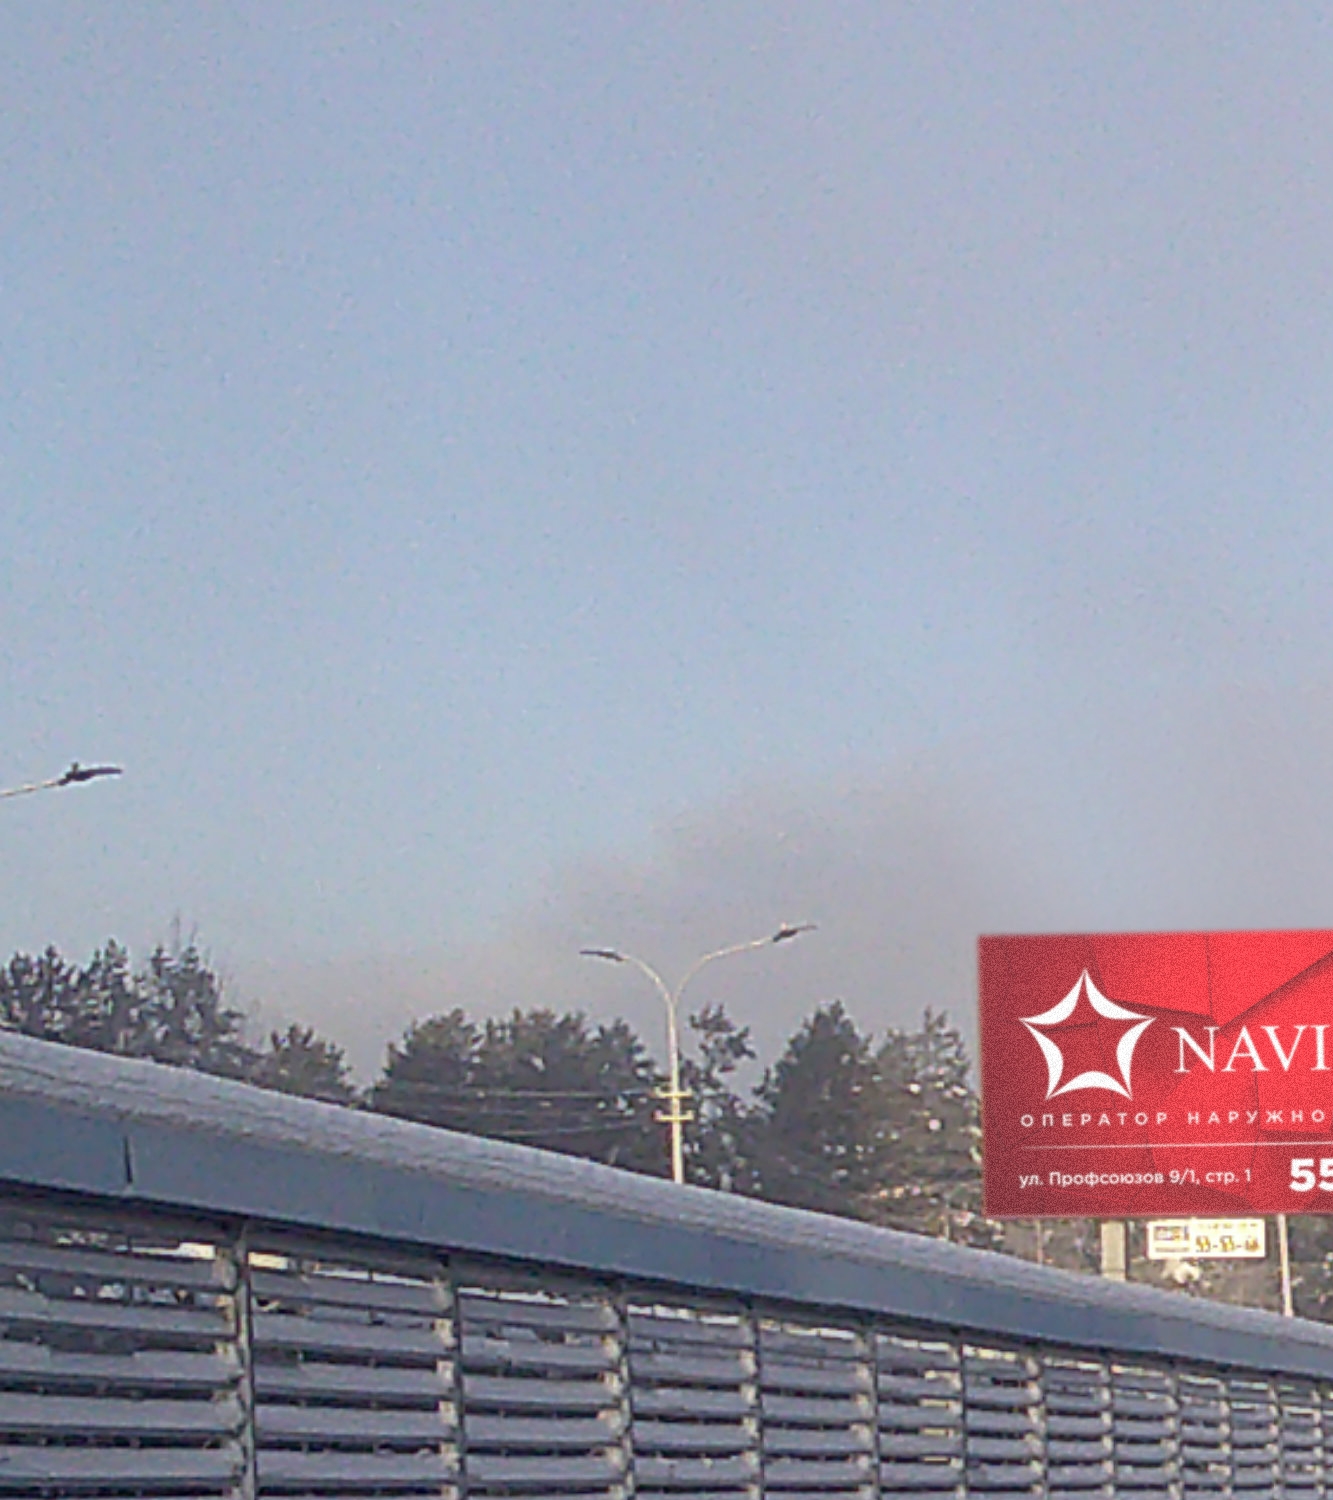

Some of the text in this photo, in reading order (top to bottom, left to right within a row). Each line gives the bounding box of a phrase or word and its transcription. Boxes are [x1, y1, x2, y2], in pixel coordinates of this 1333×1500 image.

[1020, 1111, 1168, 1128] ОПЕРАТОР
[1018, 1174, 1043, 1189] ул.
[1049, 1170, 1164, 1187] Профсоюзов
[1168, 1168, 1200, 1185] 9/1,
[1205, 1170, 1239, 1185] стр.
